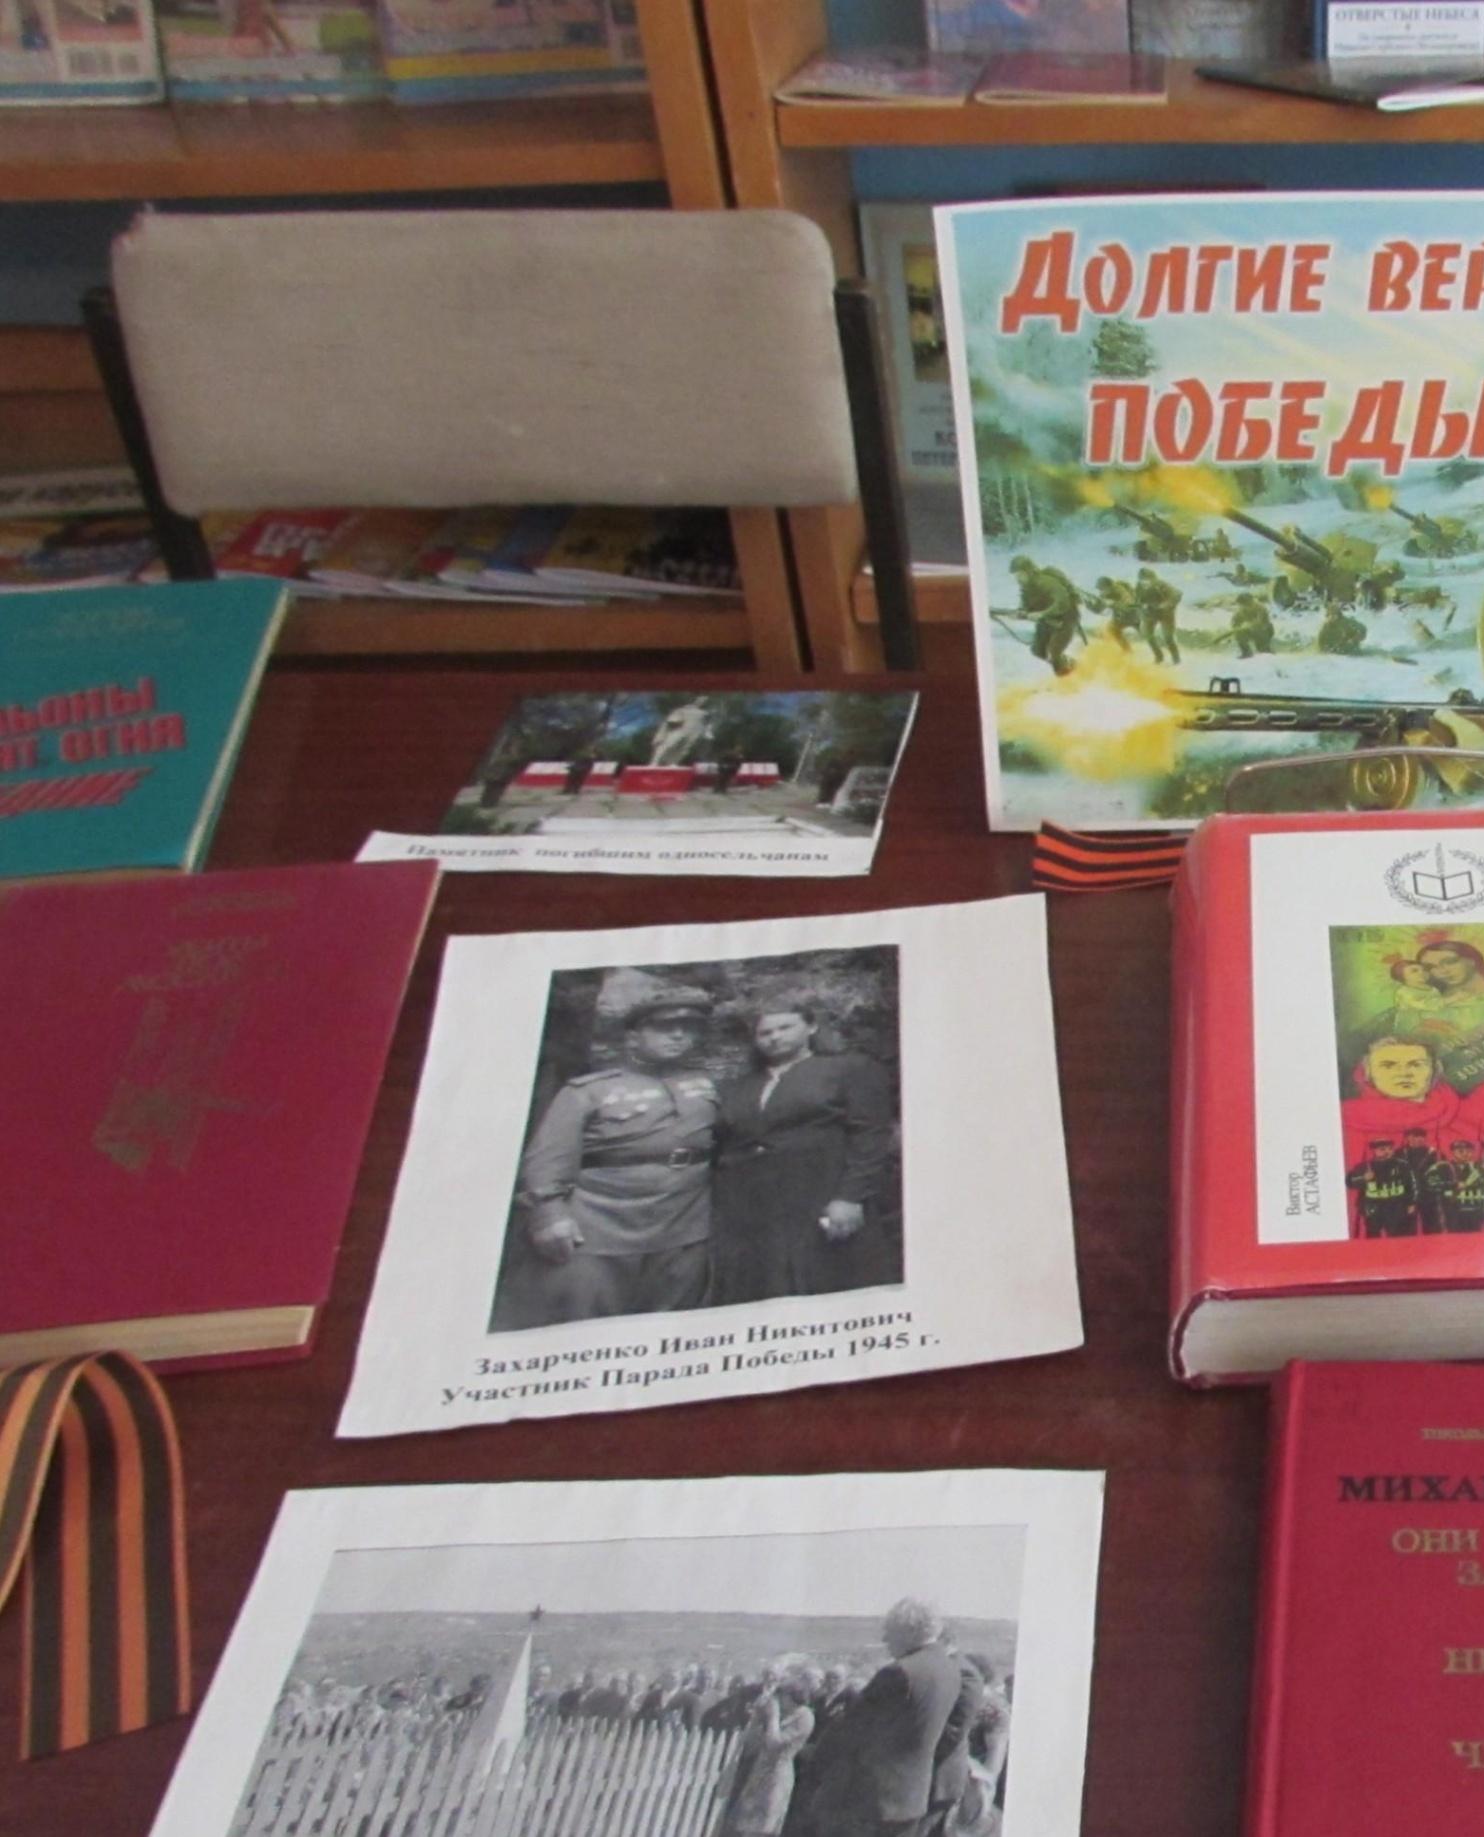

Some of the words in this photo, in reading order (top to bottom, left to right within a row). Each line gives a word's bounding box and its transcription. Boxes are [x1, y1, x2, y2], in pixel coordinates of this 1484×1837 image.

[1286, 1172, 1303, 1216] Виктор
[1302, 1145, 1321, 1216] АСТАФЬЕВ
[441, 1375, 590, 1405] Участник
[600, 1361, 710, 1390] Парада
[721, 1347, 835, 1373] Победы
[848, 1333, 911, 1357] 1945
[919, 1334, 941, 1346] г.
[474, 1344, 648, 1376] Захарченко
[658, 1335, 735, 1357] Иван
[746, 1311, 912, 1343] Никитович
[1391, 1530, 1478, 1555] ОНИ
